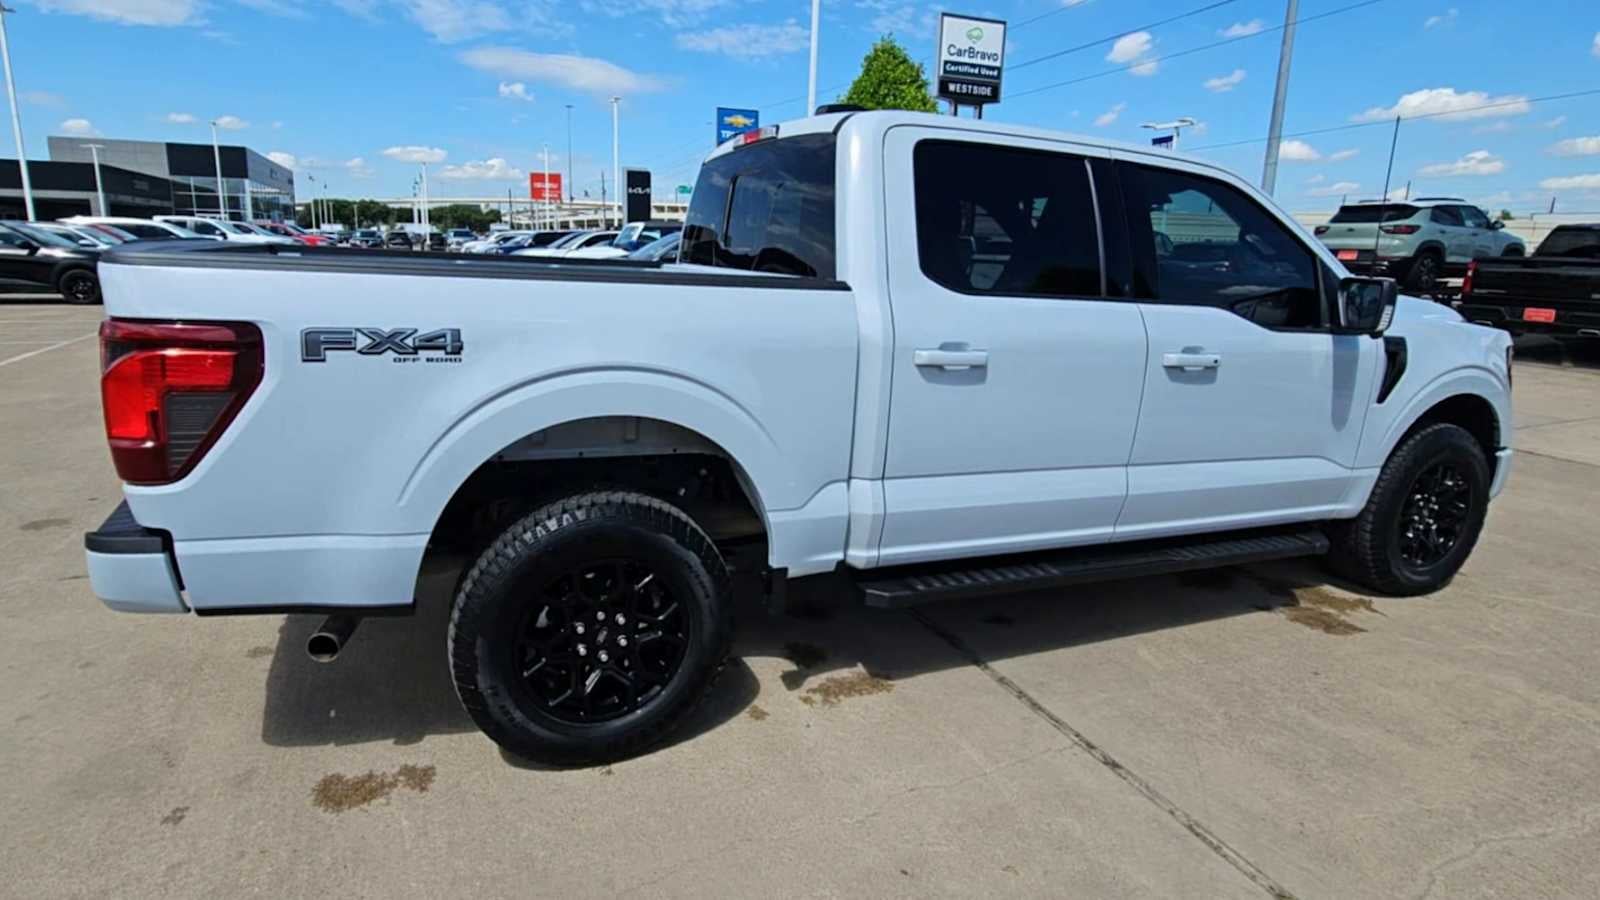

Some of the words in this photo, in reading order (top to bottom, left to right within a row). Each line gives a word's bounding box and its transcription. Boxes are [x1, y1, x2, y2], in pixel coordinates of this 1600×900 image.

[947, 44, 999, 61] CarBravo
[946, 63, 979, 74] Certified
[980, 69, 998, 77] Used
[947, 82, 993, 96] WESTSIDE
[300, 327, 463, 362] FX4
